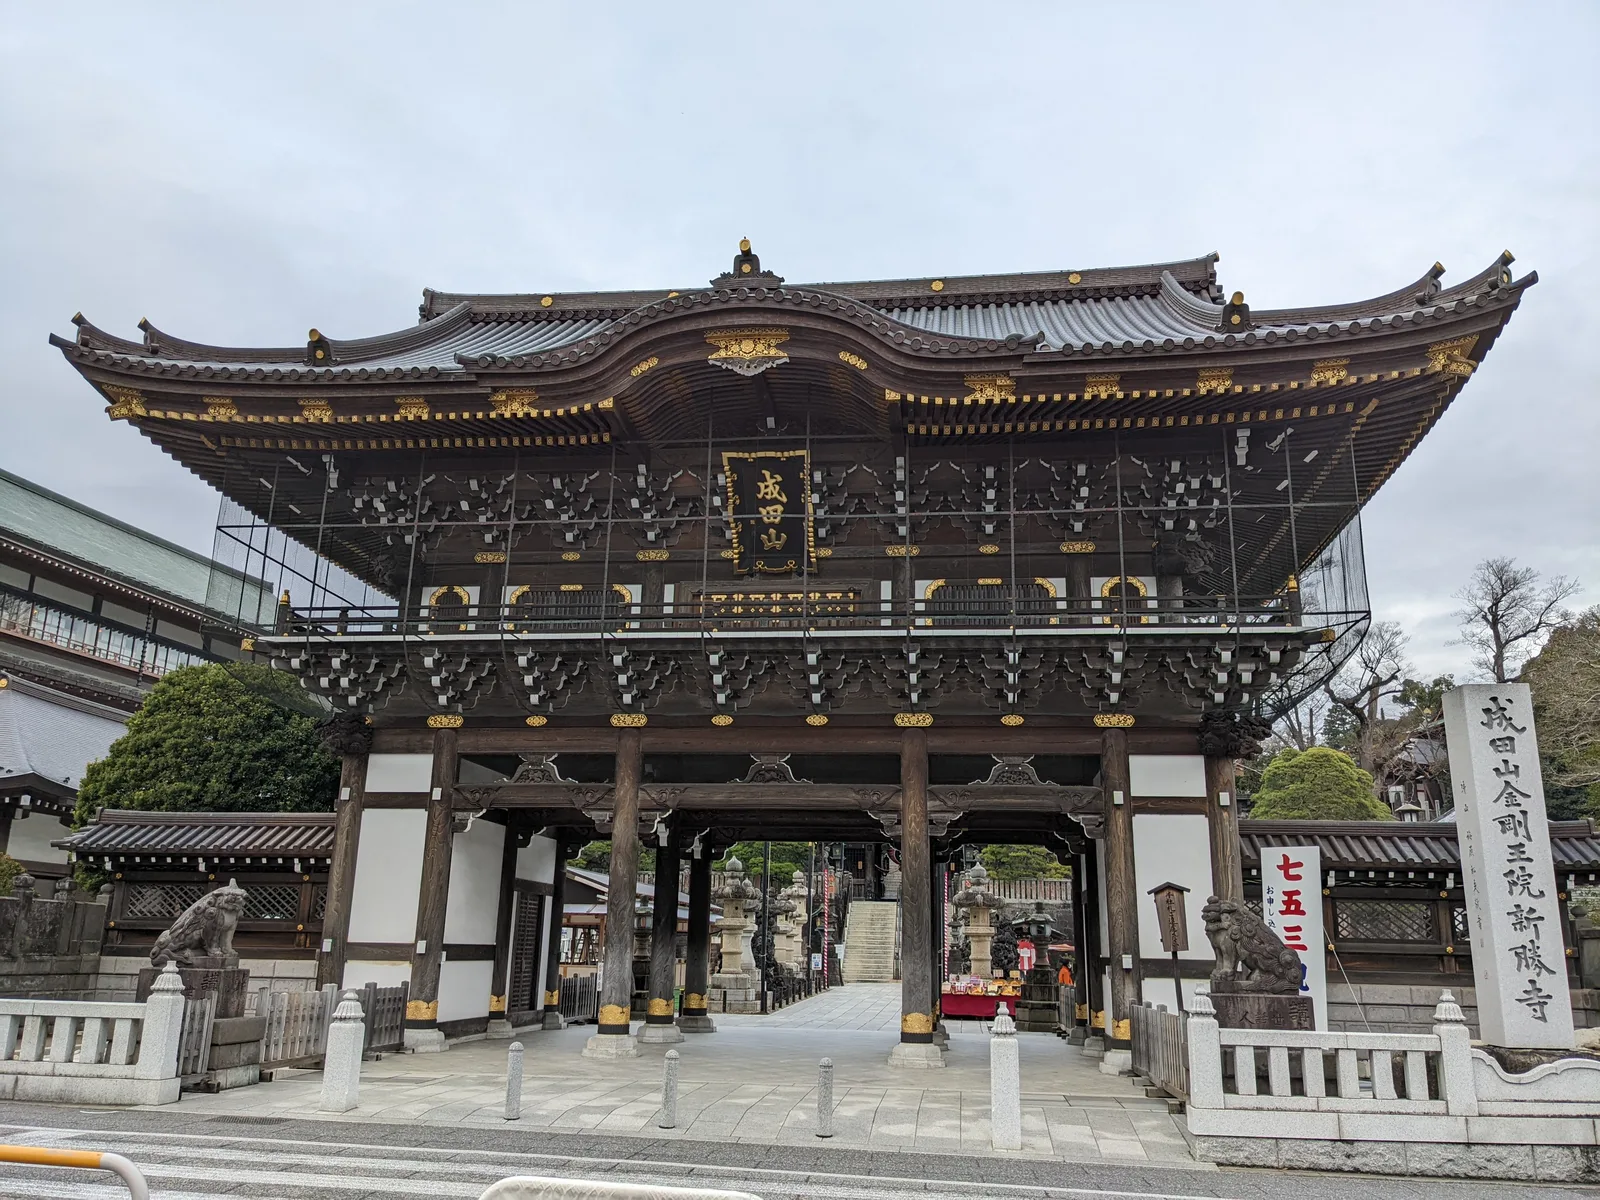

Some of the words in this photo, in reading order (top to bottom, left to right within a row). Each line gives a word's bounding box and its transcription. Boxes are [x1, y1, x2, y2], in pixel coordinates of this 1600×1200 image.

[756, 469, 788, 551] 成田山
[1480, 696, 1557, 1023] 成田山金剛王院新勝寺
